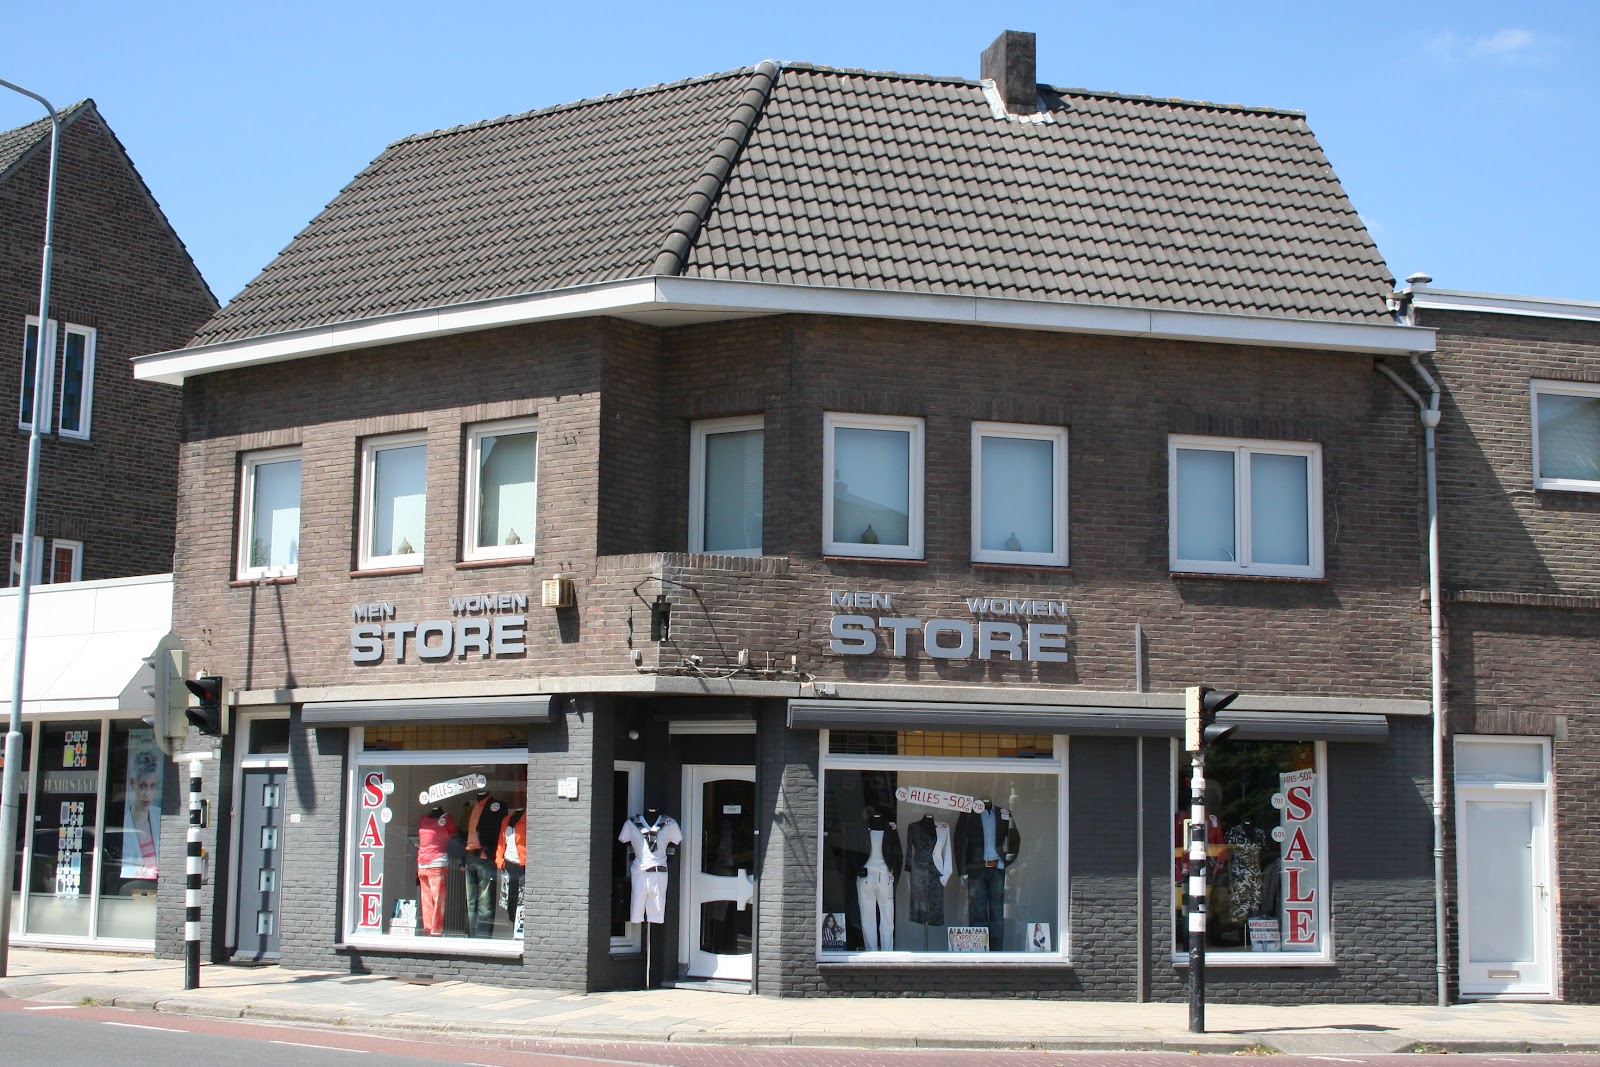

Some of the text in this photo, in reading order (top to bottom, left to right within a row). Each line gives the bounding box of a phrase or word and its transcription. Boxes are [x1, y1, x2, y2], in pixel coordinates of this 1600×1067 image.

[352, 602, 394, 619] MEN
[448, 593, 527, 613] WOMEN
[830, 592, 892, 609] MEN
[966, 597, 1068, 617] WOMEN
[351, 615, 525, 662] STORE
[830, 615, 1068, 663] STORE
[43, 779, 98, 792] HAIRSTYL
[430, 783, 454, 799] ALLES
[910, 789, 940, 805] ALLES
[359, 771, 385, 929] SALE
[1284, 785, 1316, 943] SALE
